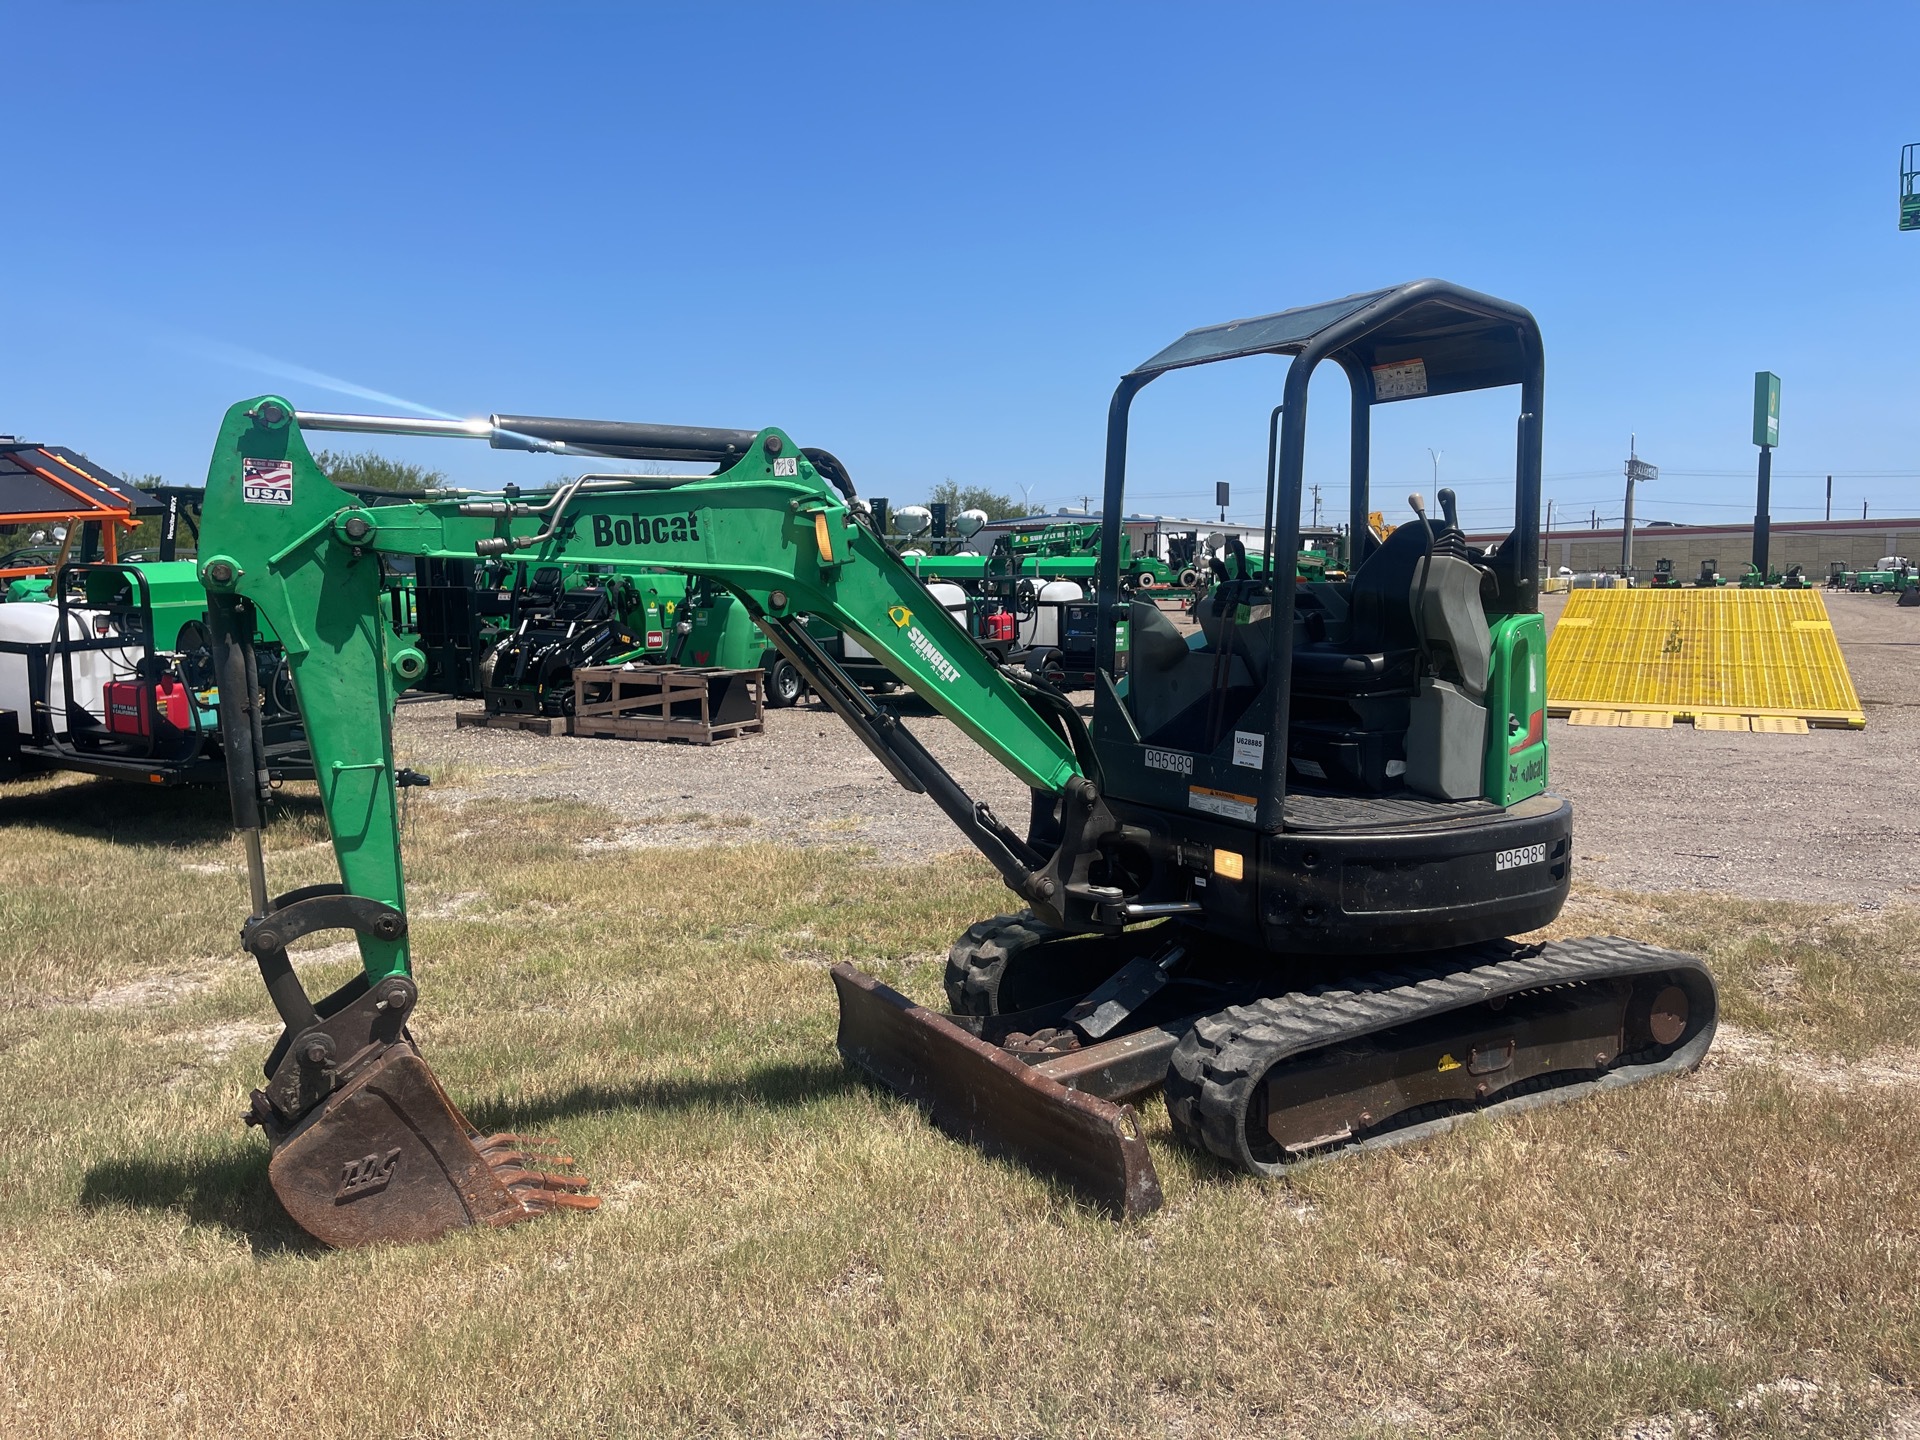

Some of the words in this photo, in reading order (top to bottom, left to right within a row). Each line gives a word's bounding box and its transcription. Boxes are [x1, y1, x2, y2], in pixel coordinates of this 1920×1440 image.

[246, 488, 289, 500] USA
[592, 511, 699, 547] Bobcat
[648, 635, 662, 643] TORO
[907, 626, 961, 683] SUNBELT
[909, 642, 946, 681] RENALS
[1236, 737, 1262, 748] U628885
[1146, 750, 1192, 774] 995989
[1214, 791, 1236, 799] WARNING
[1496, 844, 1545, 869] 995989
